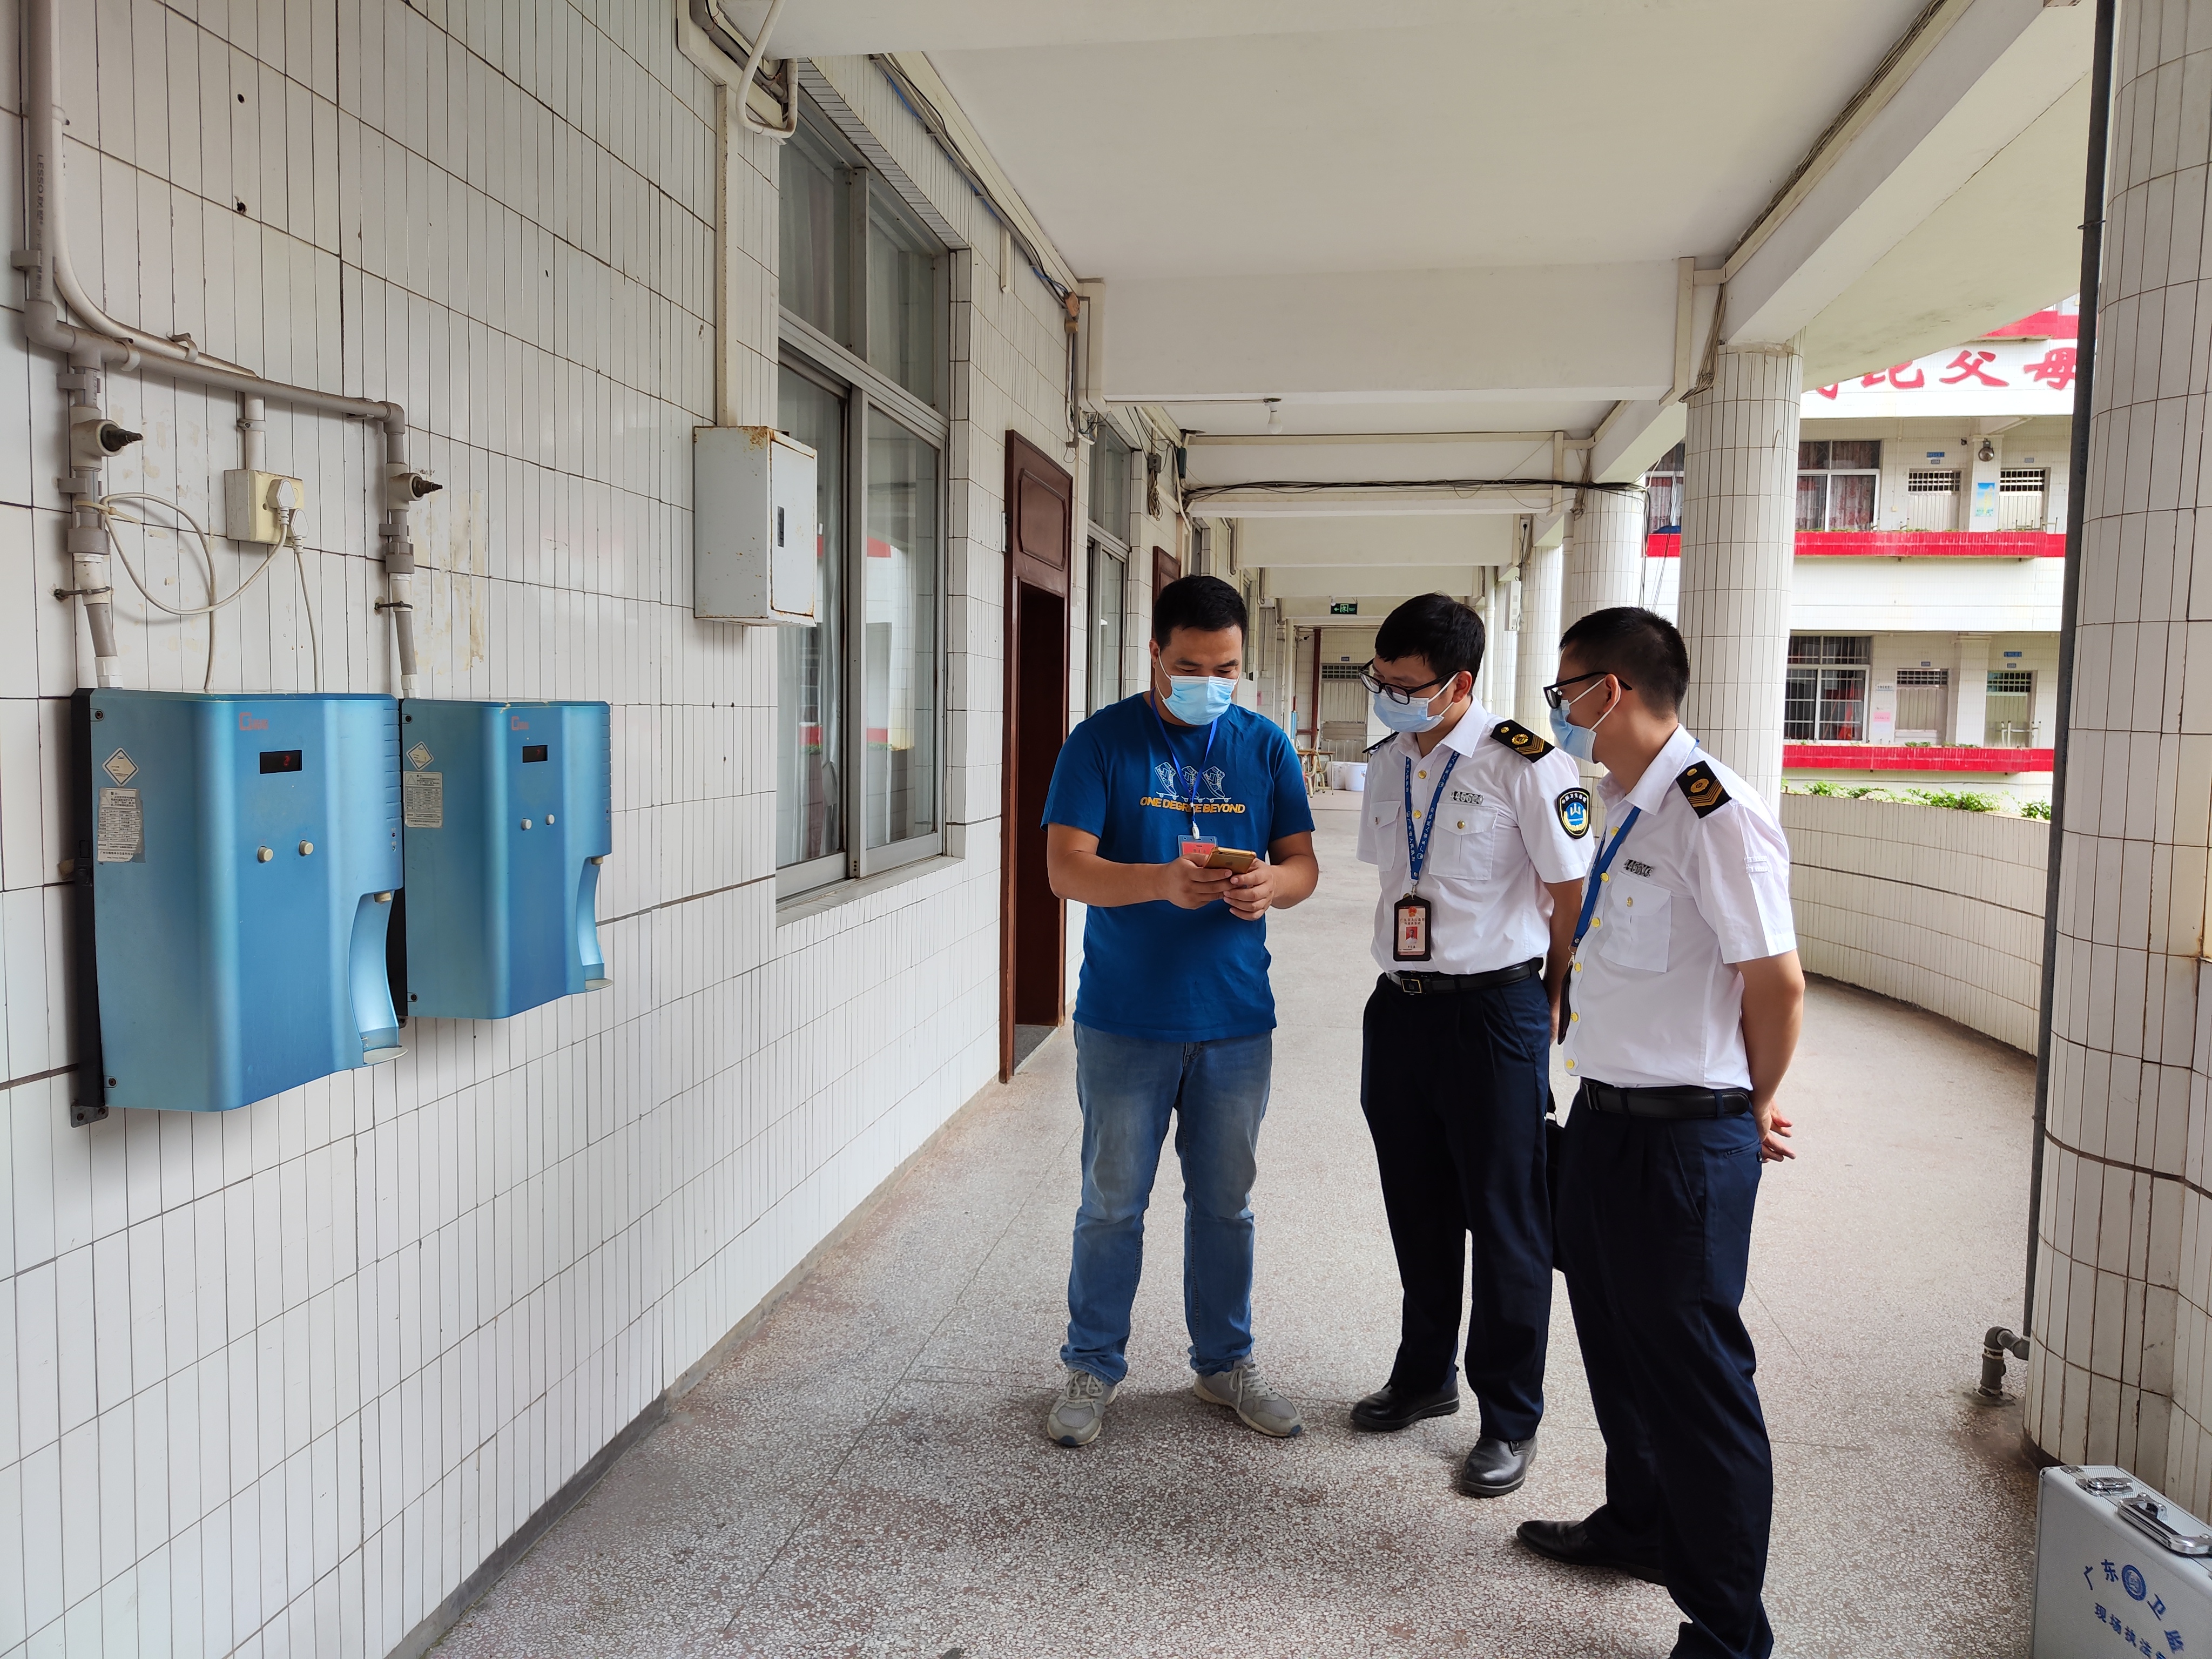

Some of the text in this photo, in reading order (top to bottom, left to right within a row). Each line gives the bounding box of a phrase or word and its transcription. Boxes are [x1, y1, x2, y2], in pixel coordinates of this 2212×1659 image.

[1140, 797, 1163, 807] ONE
[1203, 804, 1246, 813] BEYOND
[1420, 807, 1434, 853] 广东省人民政府
[2083, 1559, 2119, 1590] 广东
